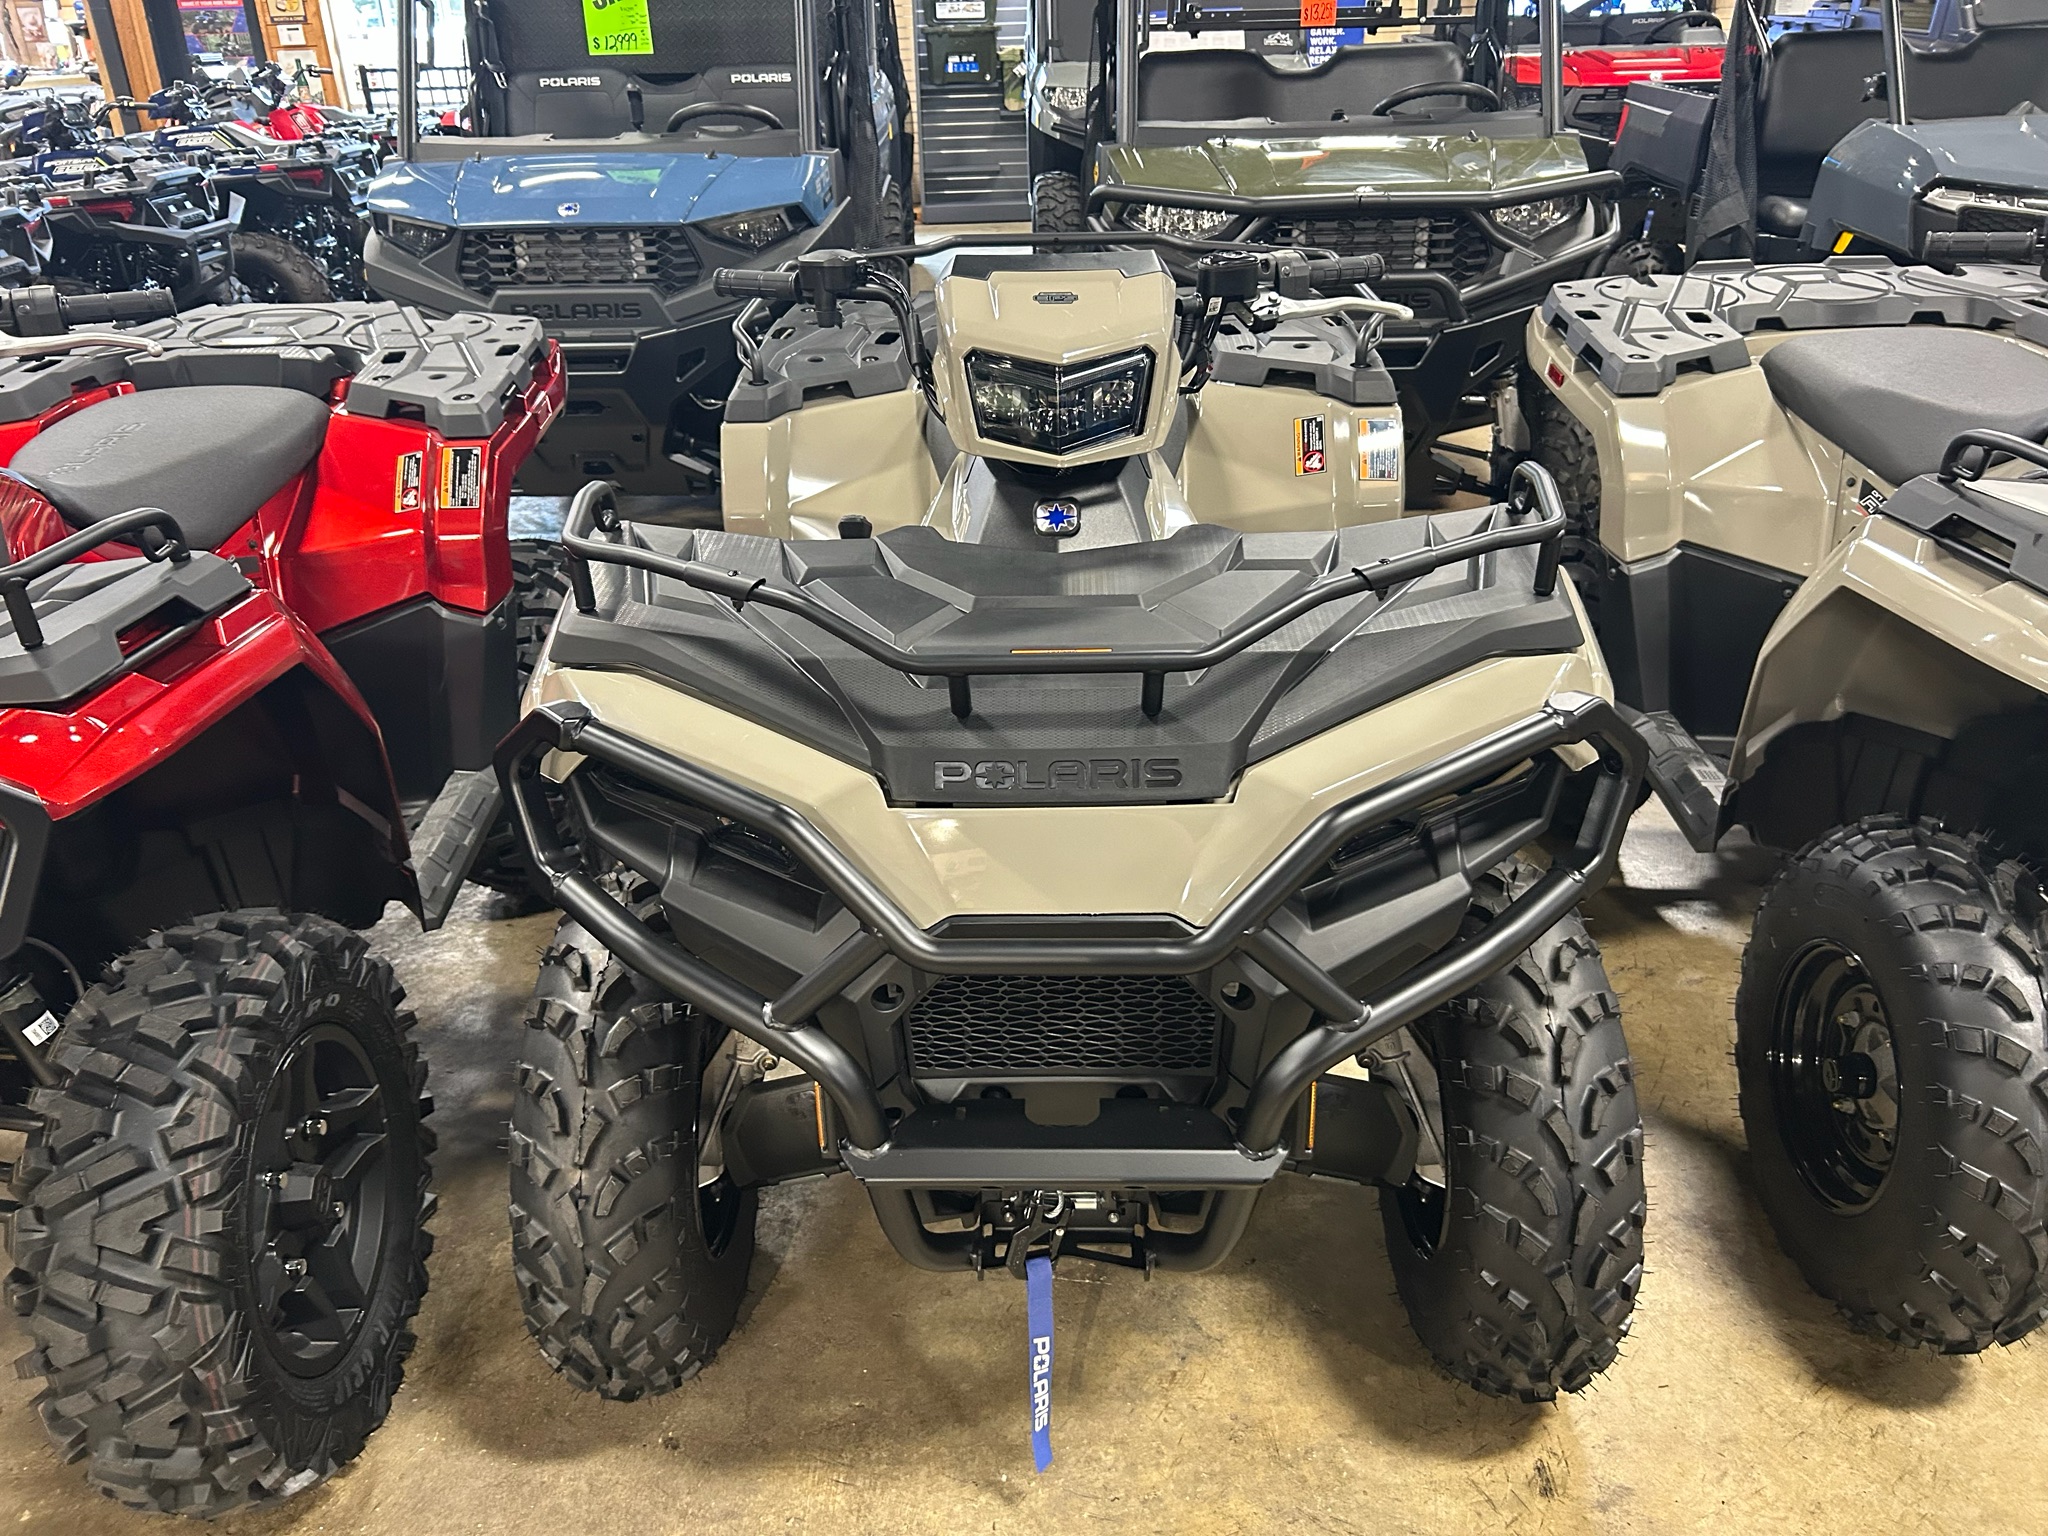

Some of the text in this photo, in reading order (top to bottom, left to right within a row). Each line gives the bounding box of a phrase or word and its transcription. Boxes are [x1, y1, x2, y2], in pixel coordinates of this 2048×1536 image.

[1309, 37, 1337, 46] WORK.
[539, 76, 601, 88] POLARIS
[731, 73, 792, 84] POLARIS
[510, 302, 642, 320] POLARIS
[933, 758, 1184, 791] POLARIS
[1032, 1335, 1051, 1433] POLARIS
